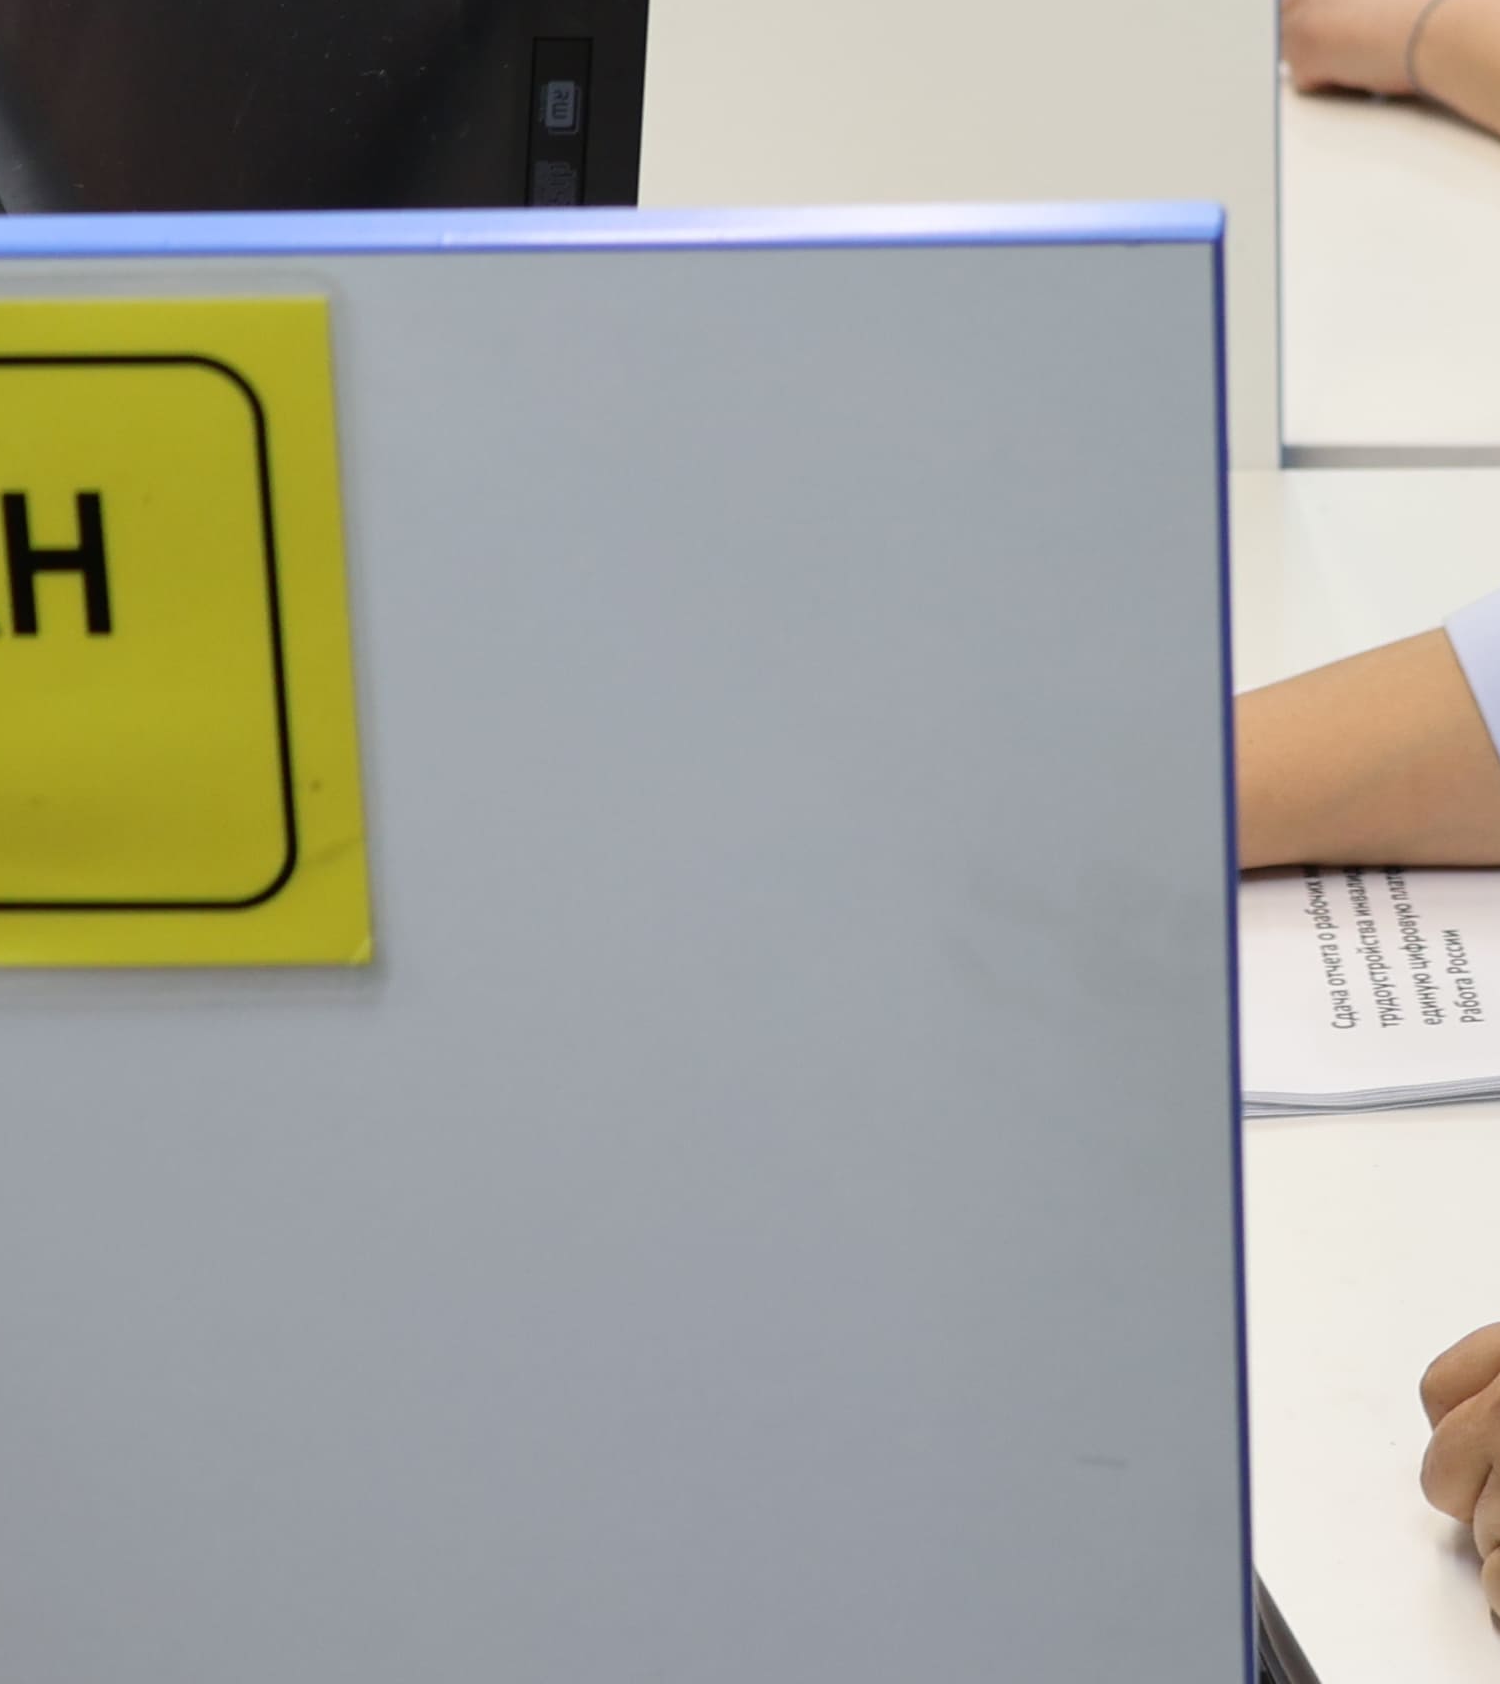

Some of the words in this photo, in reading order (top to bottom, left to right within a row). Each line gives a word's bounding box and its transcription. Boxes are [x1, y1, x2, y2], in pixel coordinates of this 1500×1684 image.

[1303, 881, 1341, 929] рабочих
[1392, 904, 1431, 969] цифровую
[1441, 929, 1470, 974] России
[1320, 945, 1347, 986] отчета
[1356, 920, 1403, 1028] трудоустройства
[1327, 990, 1358, 1029] Сдача
[1411, 973, 1445, 1025] единую
[1454, 978, 1484, 1023] Работа
